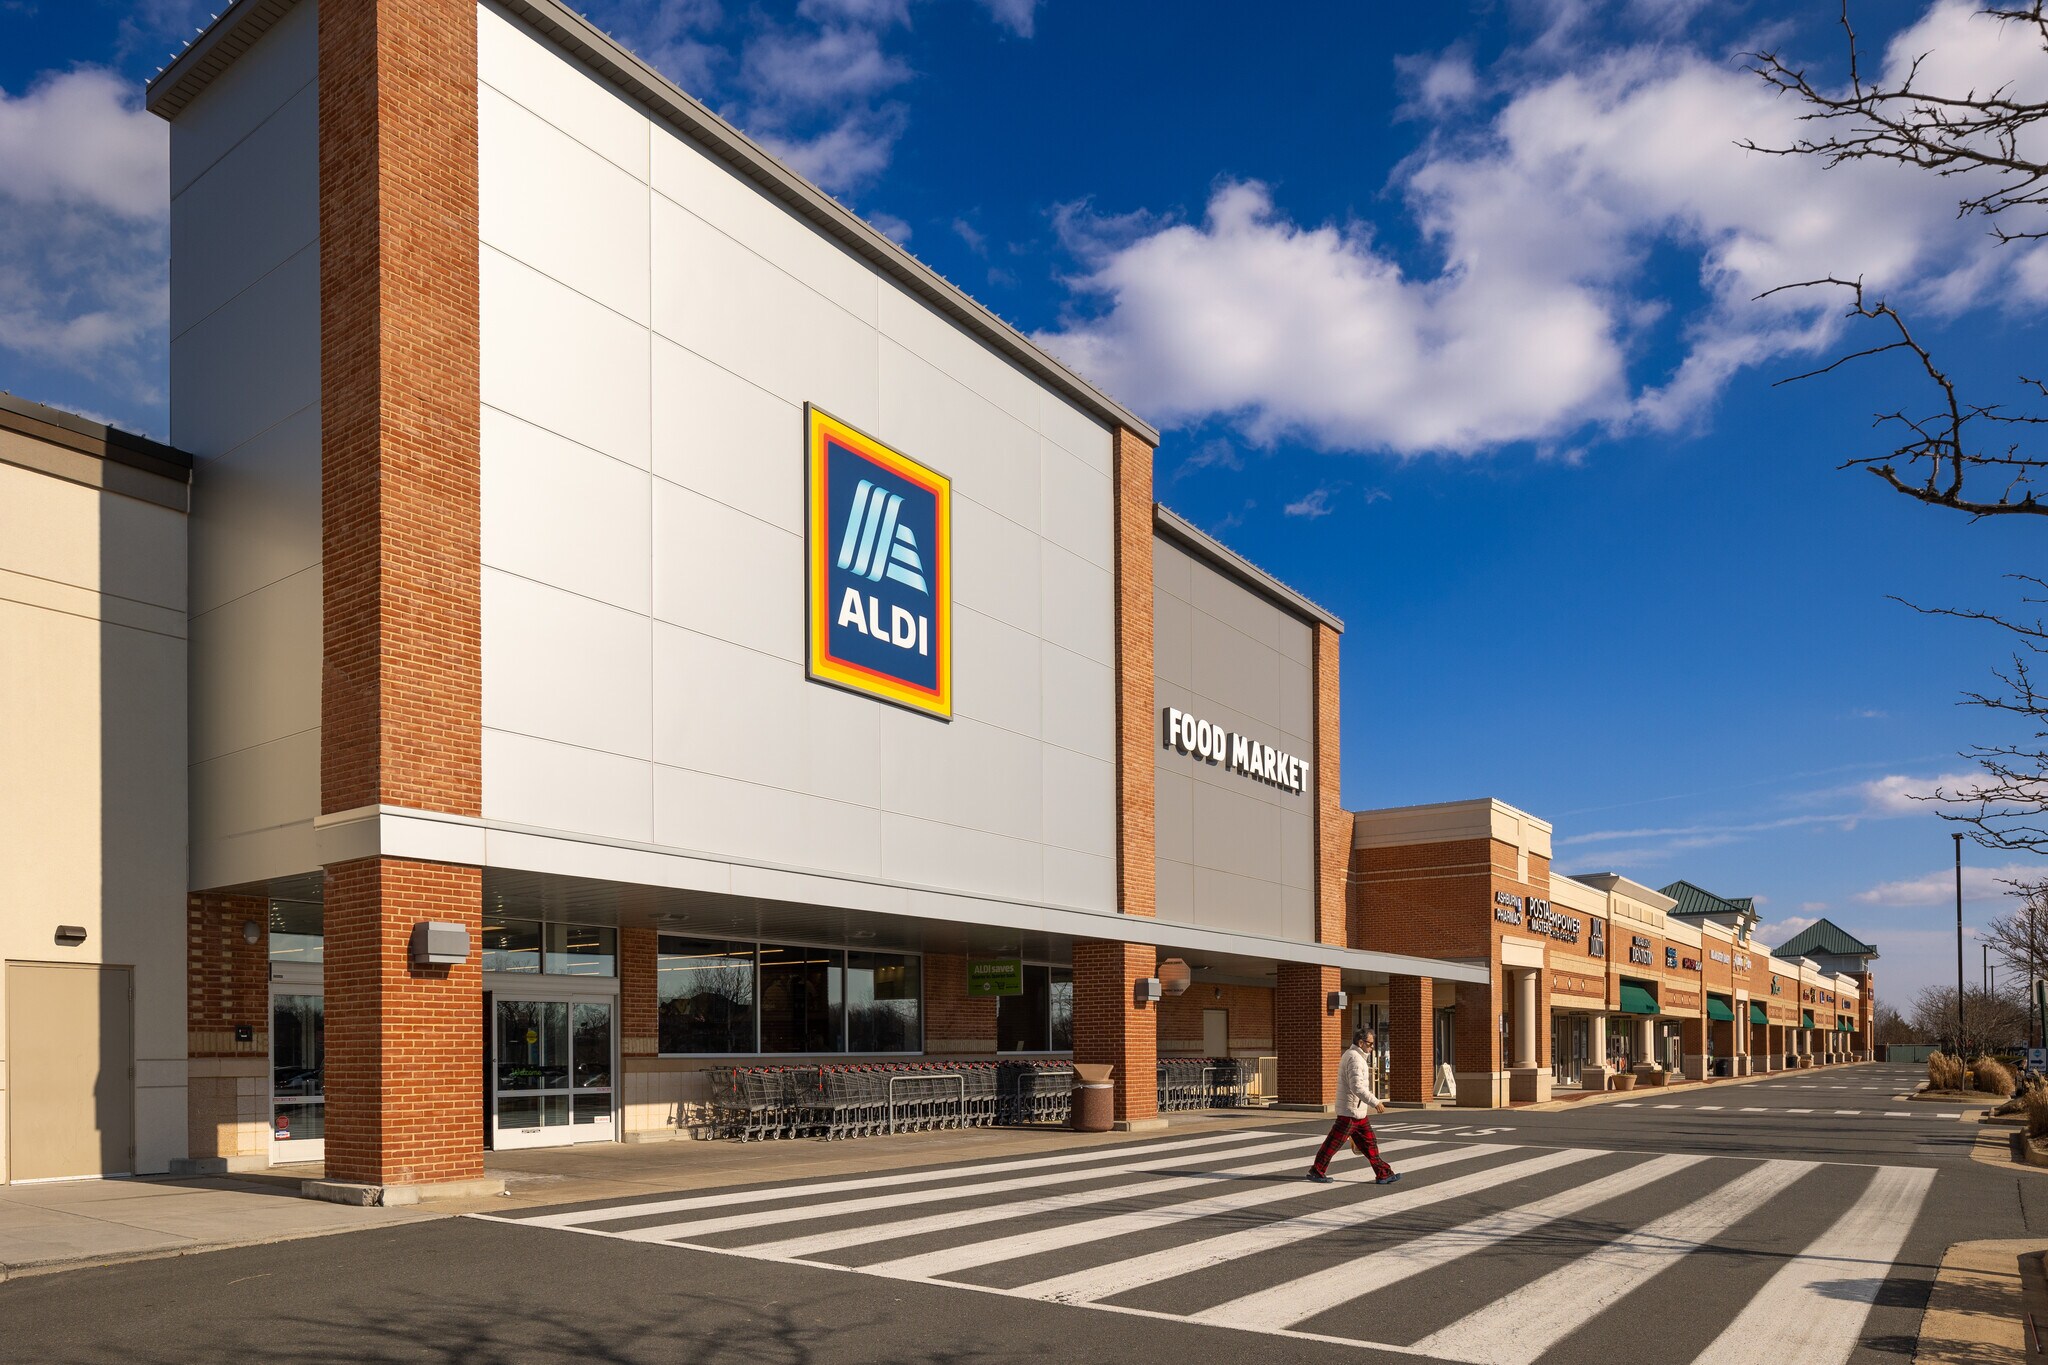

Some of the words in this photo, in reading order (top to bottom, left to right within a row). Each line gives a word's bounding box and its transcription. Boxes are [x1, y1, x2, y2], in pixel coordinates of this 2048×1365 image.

[837, 586, 928, 656] ALDI
[1168, 706, 1226, 762] FOOD
[1231, 732, 1309, 792] MARKET
[1496, 891, 1518, 907] ASHBURN
[1528, 896, 1552, 920] POSTAL
[1496, 908, 1523, 925] PHARMACY
[1632, 946, 1654, 966] DENTISTRY
[974, 964, 991, 974] ALDI
[991, 964, 1015, 973] saves
